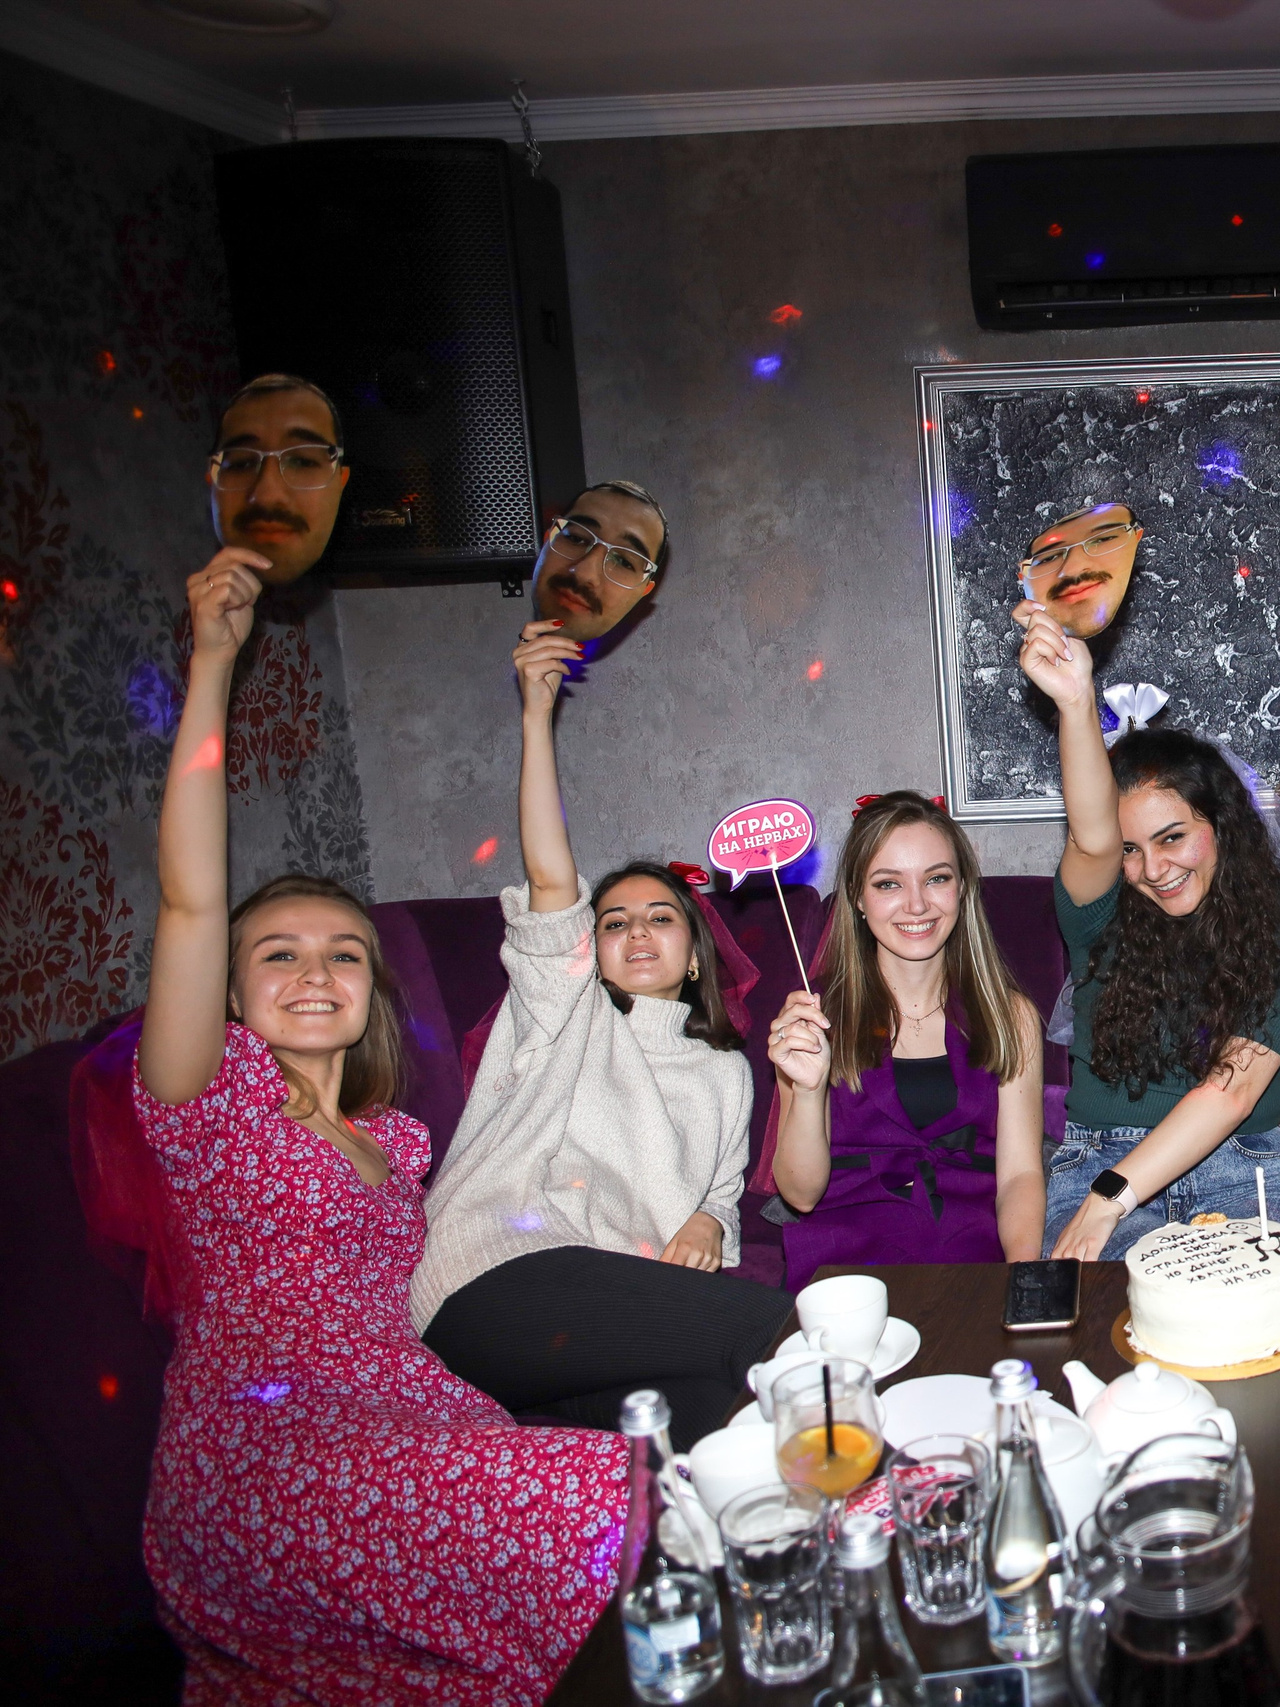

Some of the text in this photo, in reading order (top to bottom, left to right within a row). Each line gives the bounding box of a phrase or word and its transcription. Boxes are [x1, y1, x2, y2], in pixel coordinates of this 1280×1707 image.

[722, 811, 795, 839] ИГРАЮ
[717, 822, 808, 856] НА НЕРВАХ!
[1165, 1256, 1232, 1281] НО ДЕНЕГ
[1186, 1263, 1250, 1284] ХВАТИЛО
[1221, 1275, 1244, 1286] НА
